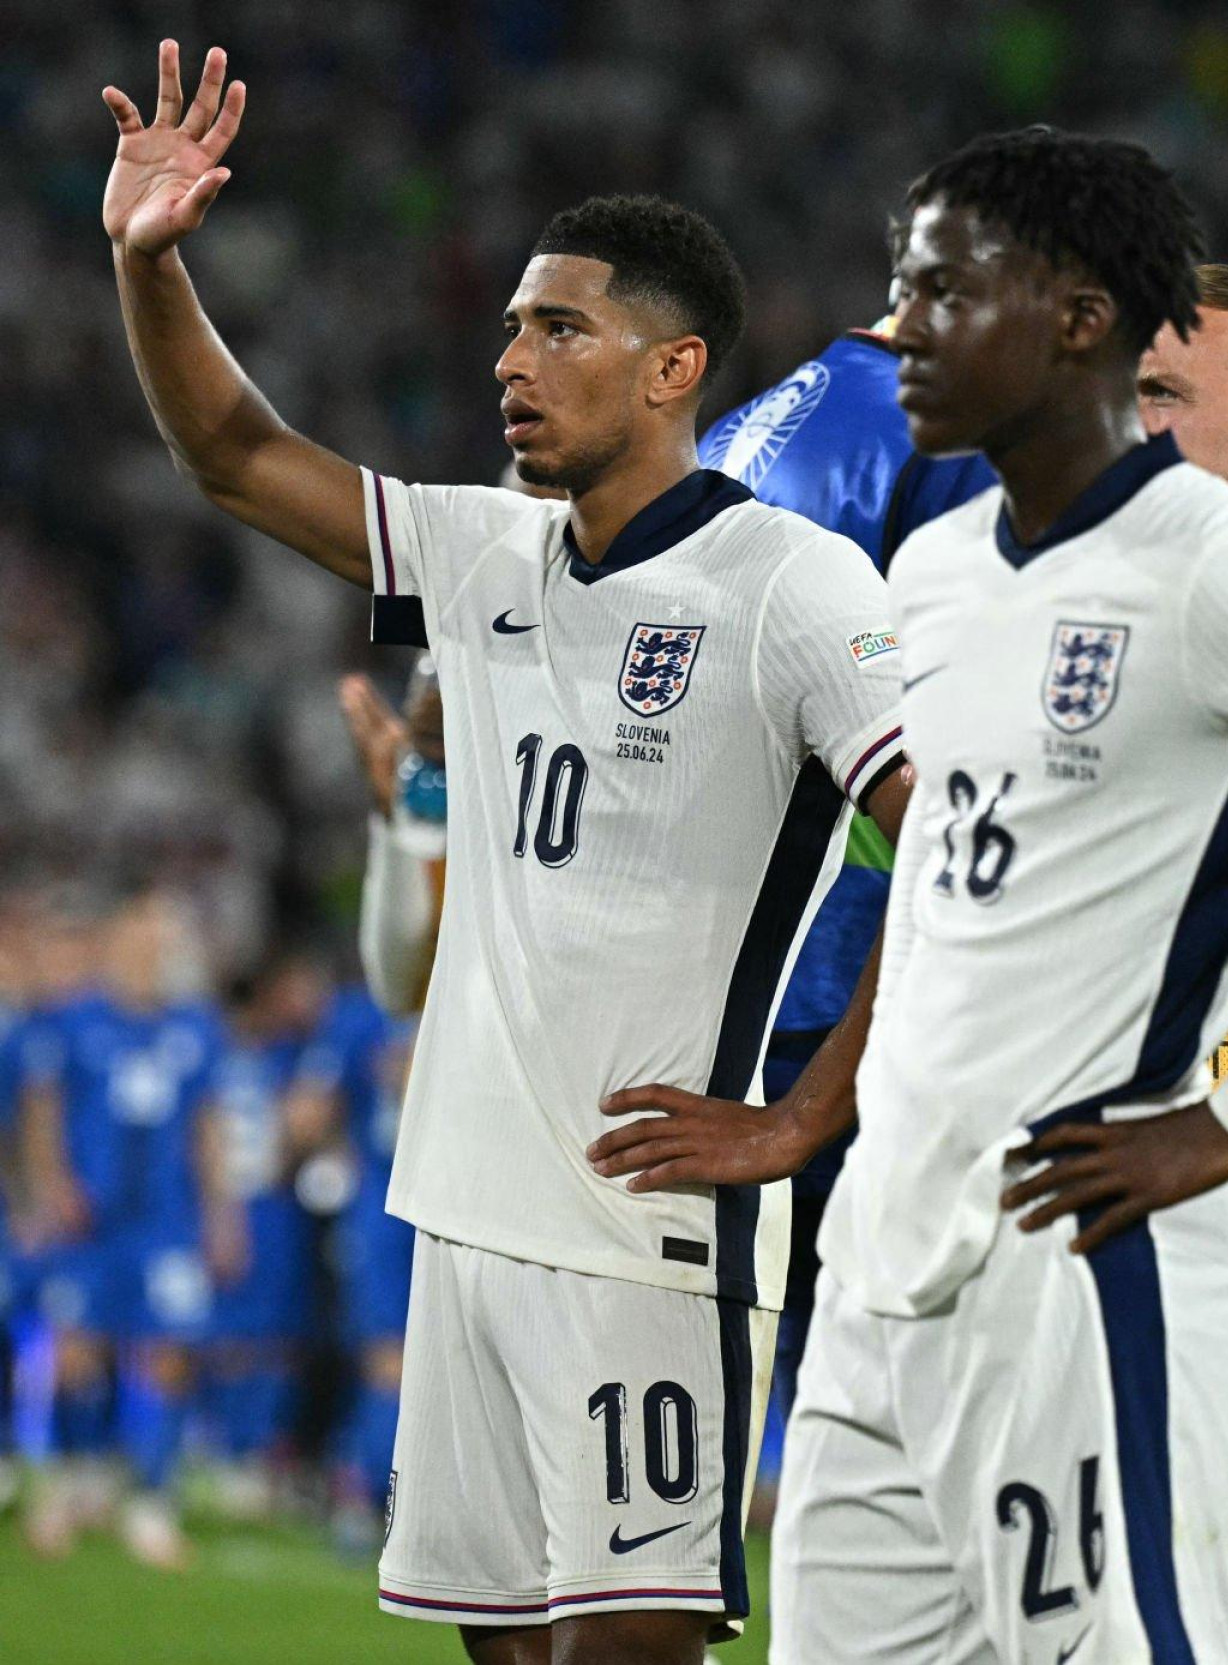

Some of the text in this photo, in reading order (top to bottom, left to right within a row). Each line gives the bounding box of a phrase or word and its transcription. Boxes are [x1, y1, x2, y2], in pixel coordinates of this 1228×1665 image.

[848, 632, 873, 646] UEFA
[615, 722, 671, 745] SLOVENIA
[616, 742, 664, 764] 25.06.24
[513, 732, 589, 869] 10
[933, 769, 1018, 907] 26
[588, 1380, 699, 1505] 10
